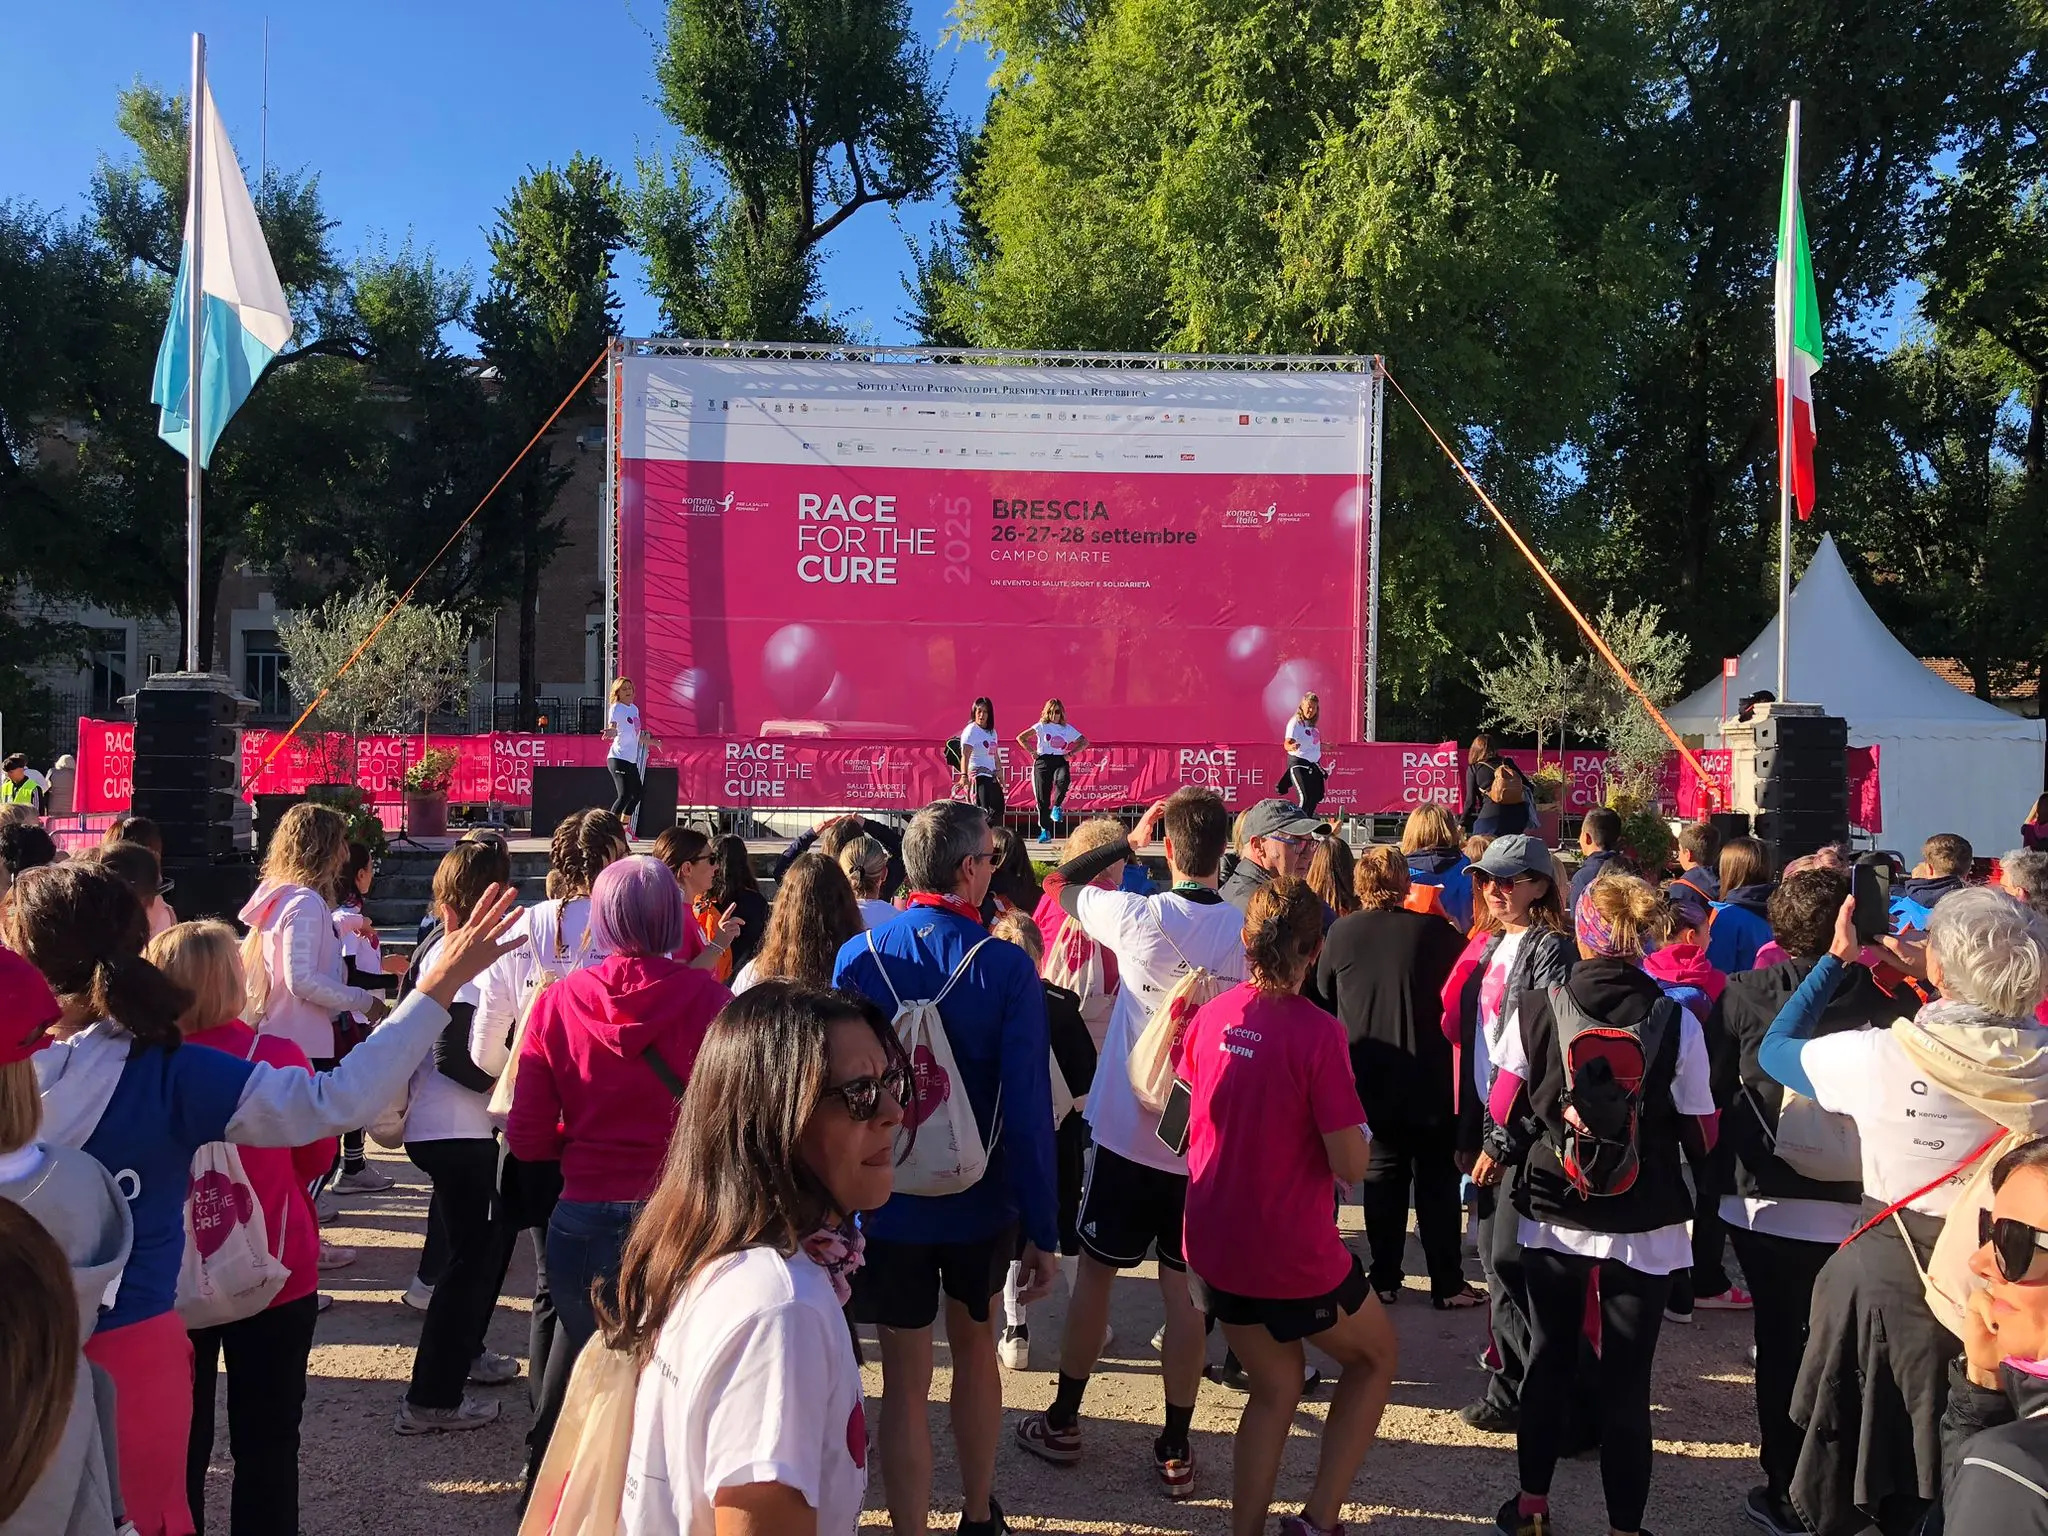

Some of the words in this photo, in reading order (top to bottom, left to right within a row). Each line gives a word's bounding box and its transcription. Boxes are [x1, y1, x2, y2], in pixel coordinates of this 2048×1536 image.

[856, 381, 888, 391] SOTTO
[927, 383, 980, 394] PATRONATO
[1002, 385, 1057, 396] PRESIDENTE
[1090, 386, 1148, 398] REPUBBLICA
[798, 493, 897, 523] RACE
[991, 498, 1110, 521] BRESCIA
[798, 525, 866, 552] FOR
[872, 527, 937, 555] THE
[944, 496, 971, 585] 2025
[991, 525, 1085, 544] 26-27-28
[1091, 526, 1197, 545] settembre
[990, 549, 1049, 562] CAMPO
[1056, 550, 1110, 563] MARTE
[796, 555, 898, 585] CURE
[1002, 579, 1031, 587] EVENTO
[1071, 580, 1094, 588] SPORT
[1103, 580, 1151, 588] SOLIDARIETÀ
[357, 741, 416, 757] RACE
[494, 739, 546, 757] RACE
[725, 743, 785, 760] RACE
[1179, 748, 1237, 766] RACE
[103, 755, 129, 776] FOR
[357, 758, 399, 775] FOR
[495, 757, 529, 776] FOR
[1402, 751, 1459, 768] RACE
[725, 761, 768, 778] FOR
[773, 762, 813, 779] THE
[1179, 767, 1220, 784] FOR
[1225, 768, 1264, 785] THE
[1403, 769, 1445, 785] FOR
[494, 774, 533, 796] CUR
[724, 779, 786, 797] CURE
[846, 789, 907, 799] SOLIDARIETÀ
[1402, 786, 1459, 804] CURE
[1221, 1022, 1262, 1043] Aveeno
